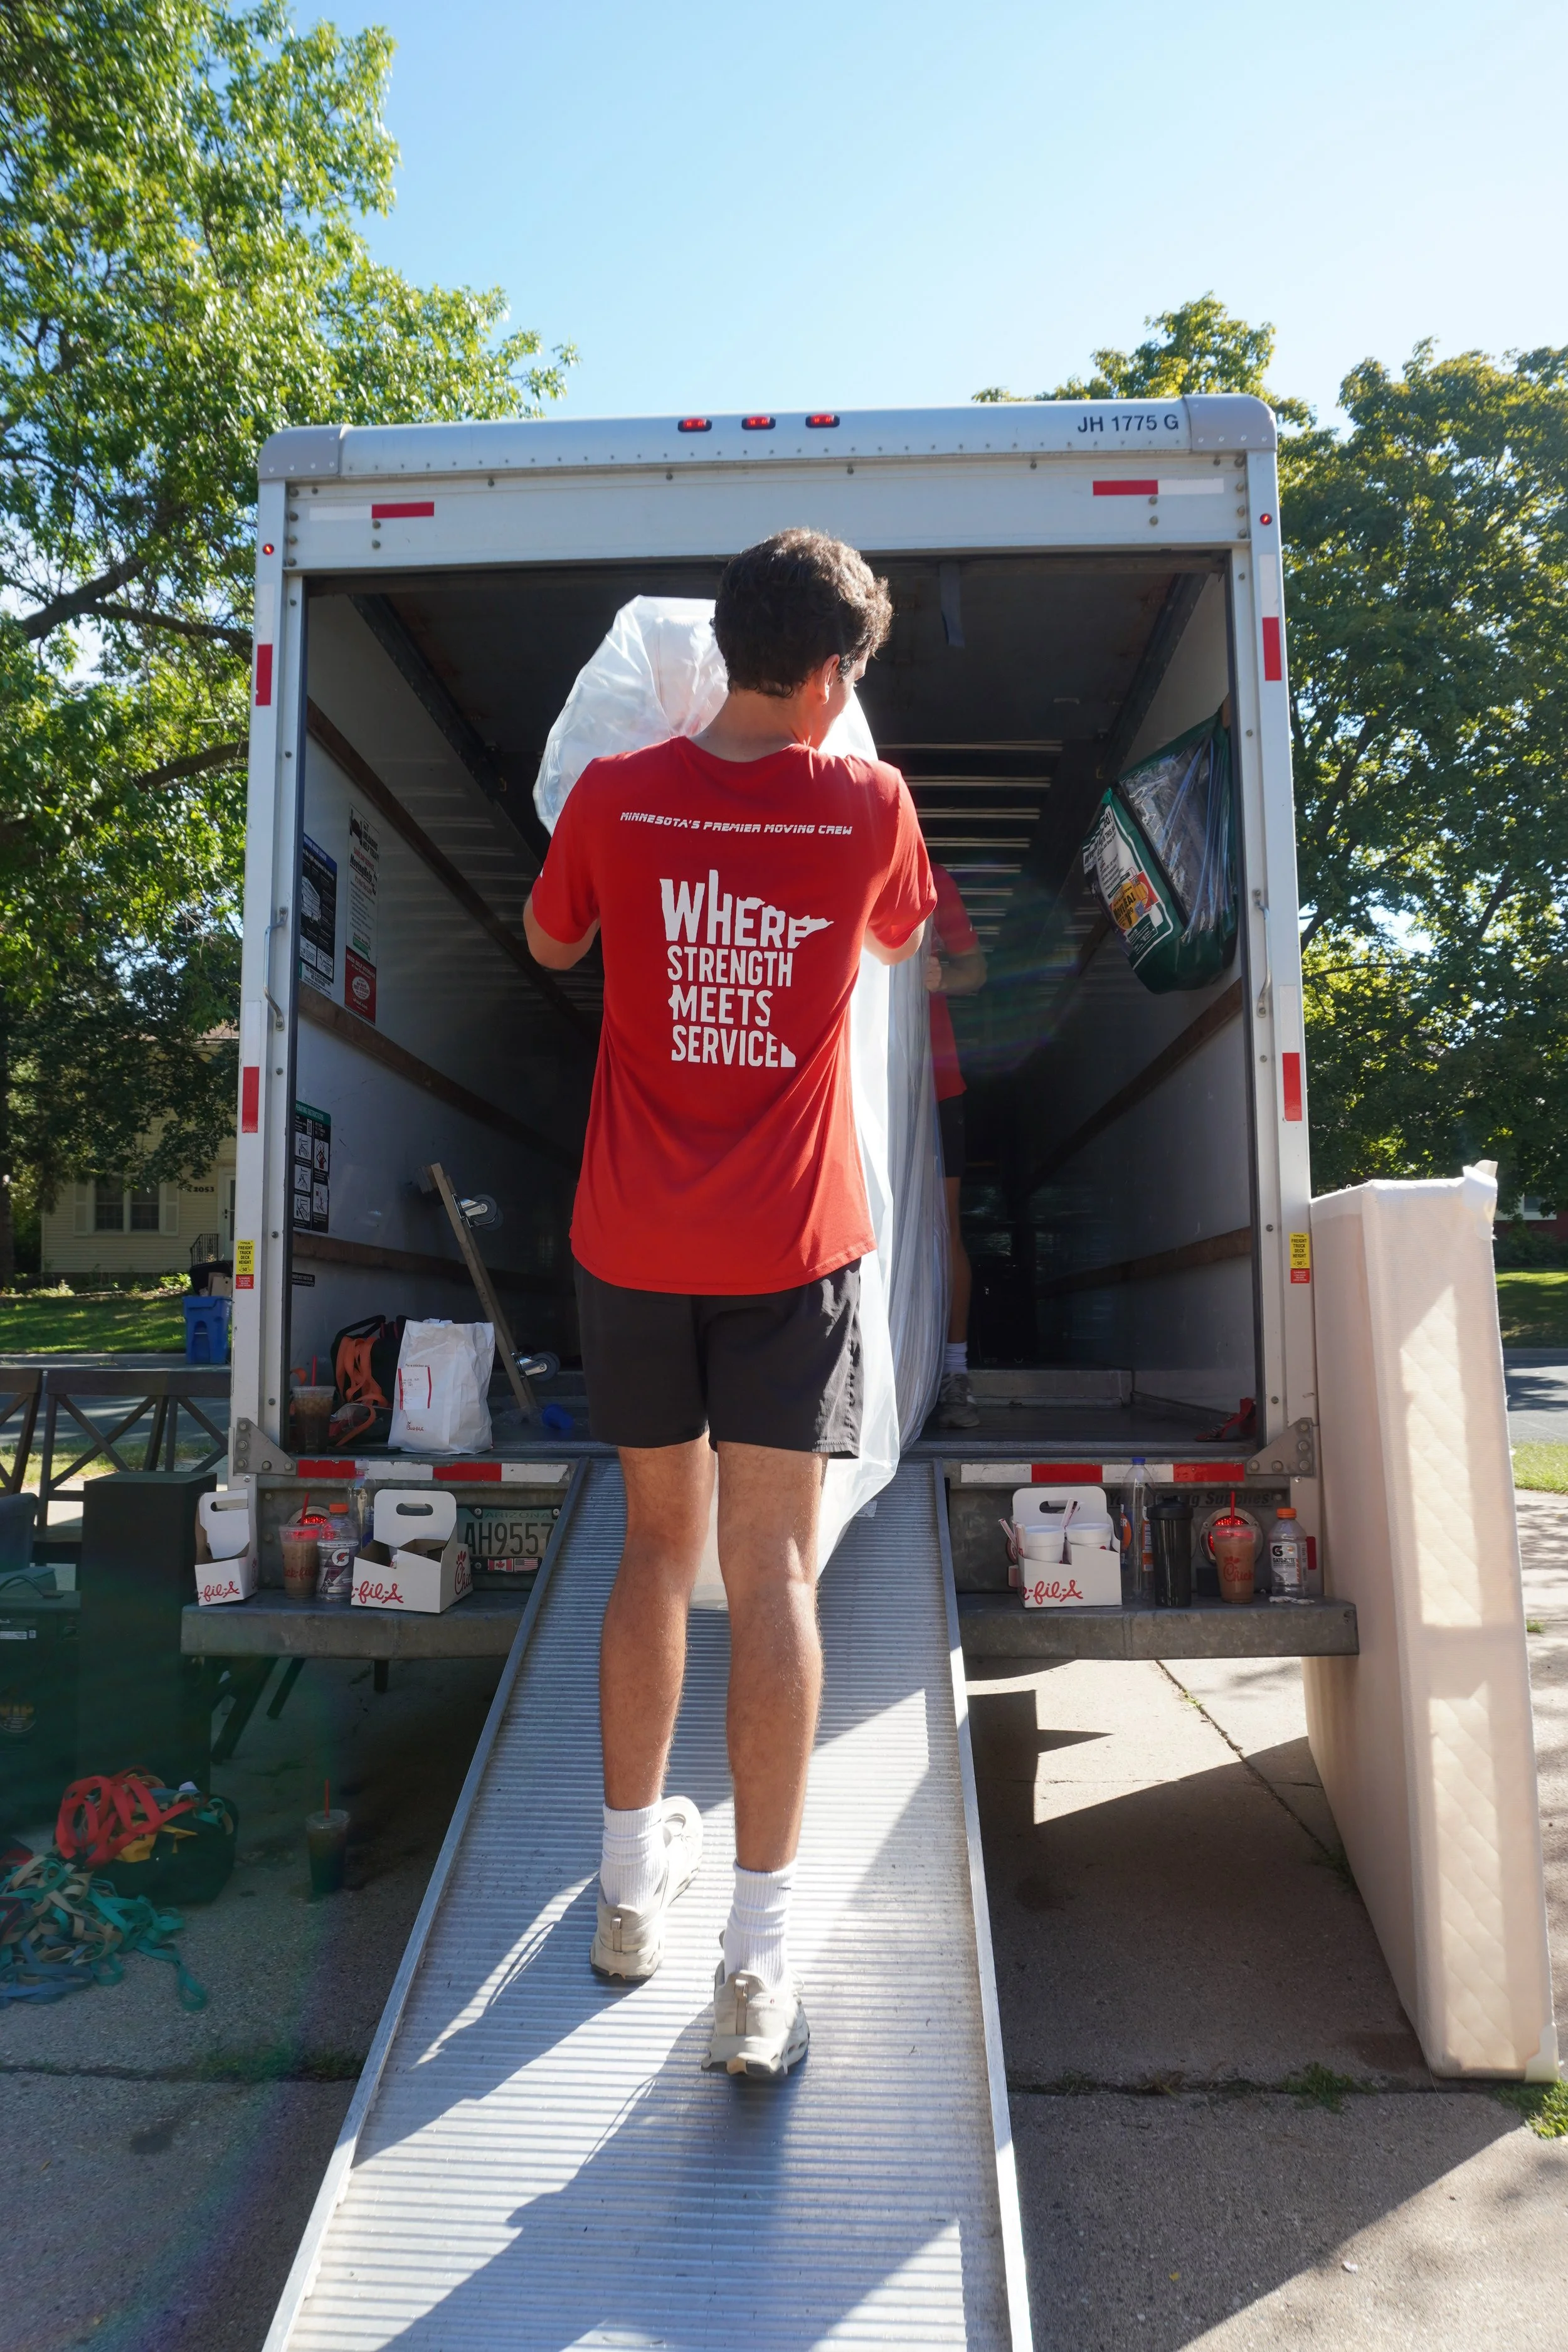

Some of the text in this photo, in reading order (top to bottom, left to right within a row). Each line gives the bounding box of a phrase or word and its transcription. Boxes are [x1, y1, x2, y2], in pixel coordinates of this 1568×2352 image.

[1078, 414, 1179, 433] JH 1775 G
[620, 811, 853, 835] MINNESOTA'S PREMIER MOVING CREW
[659, 869, 835, 948] WHERE
[667, 945, 793, 987] STRENGTH
[667, 984, 774, 1027] MEETS
[671, 1024, 778, 1067] SERVICE
